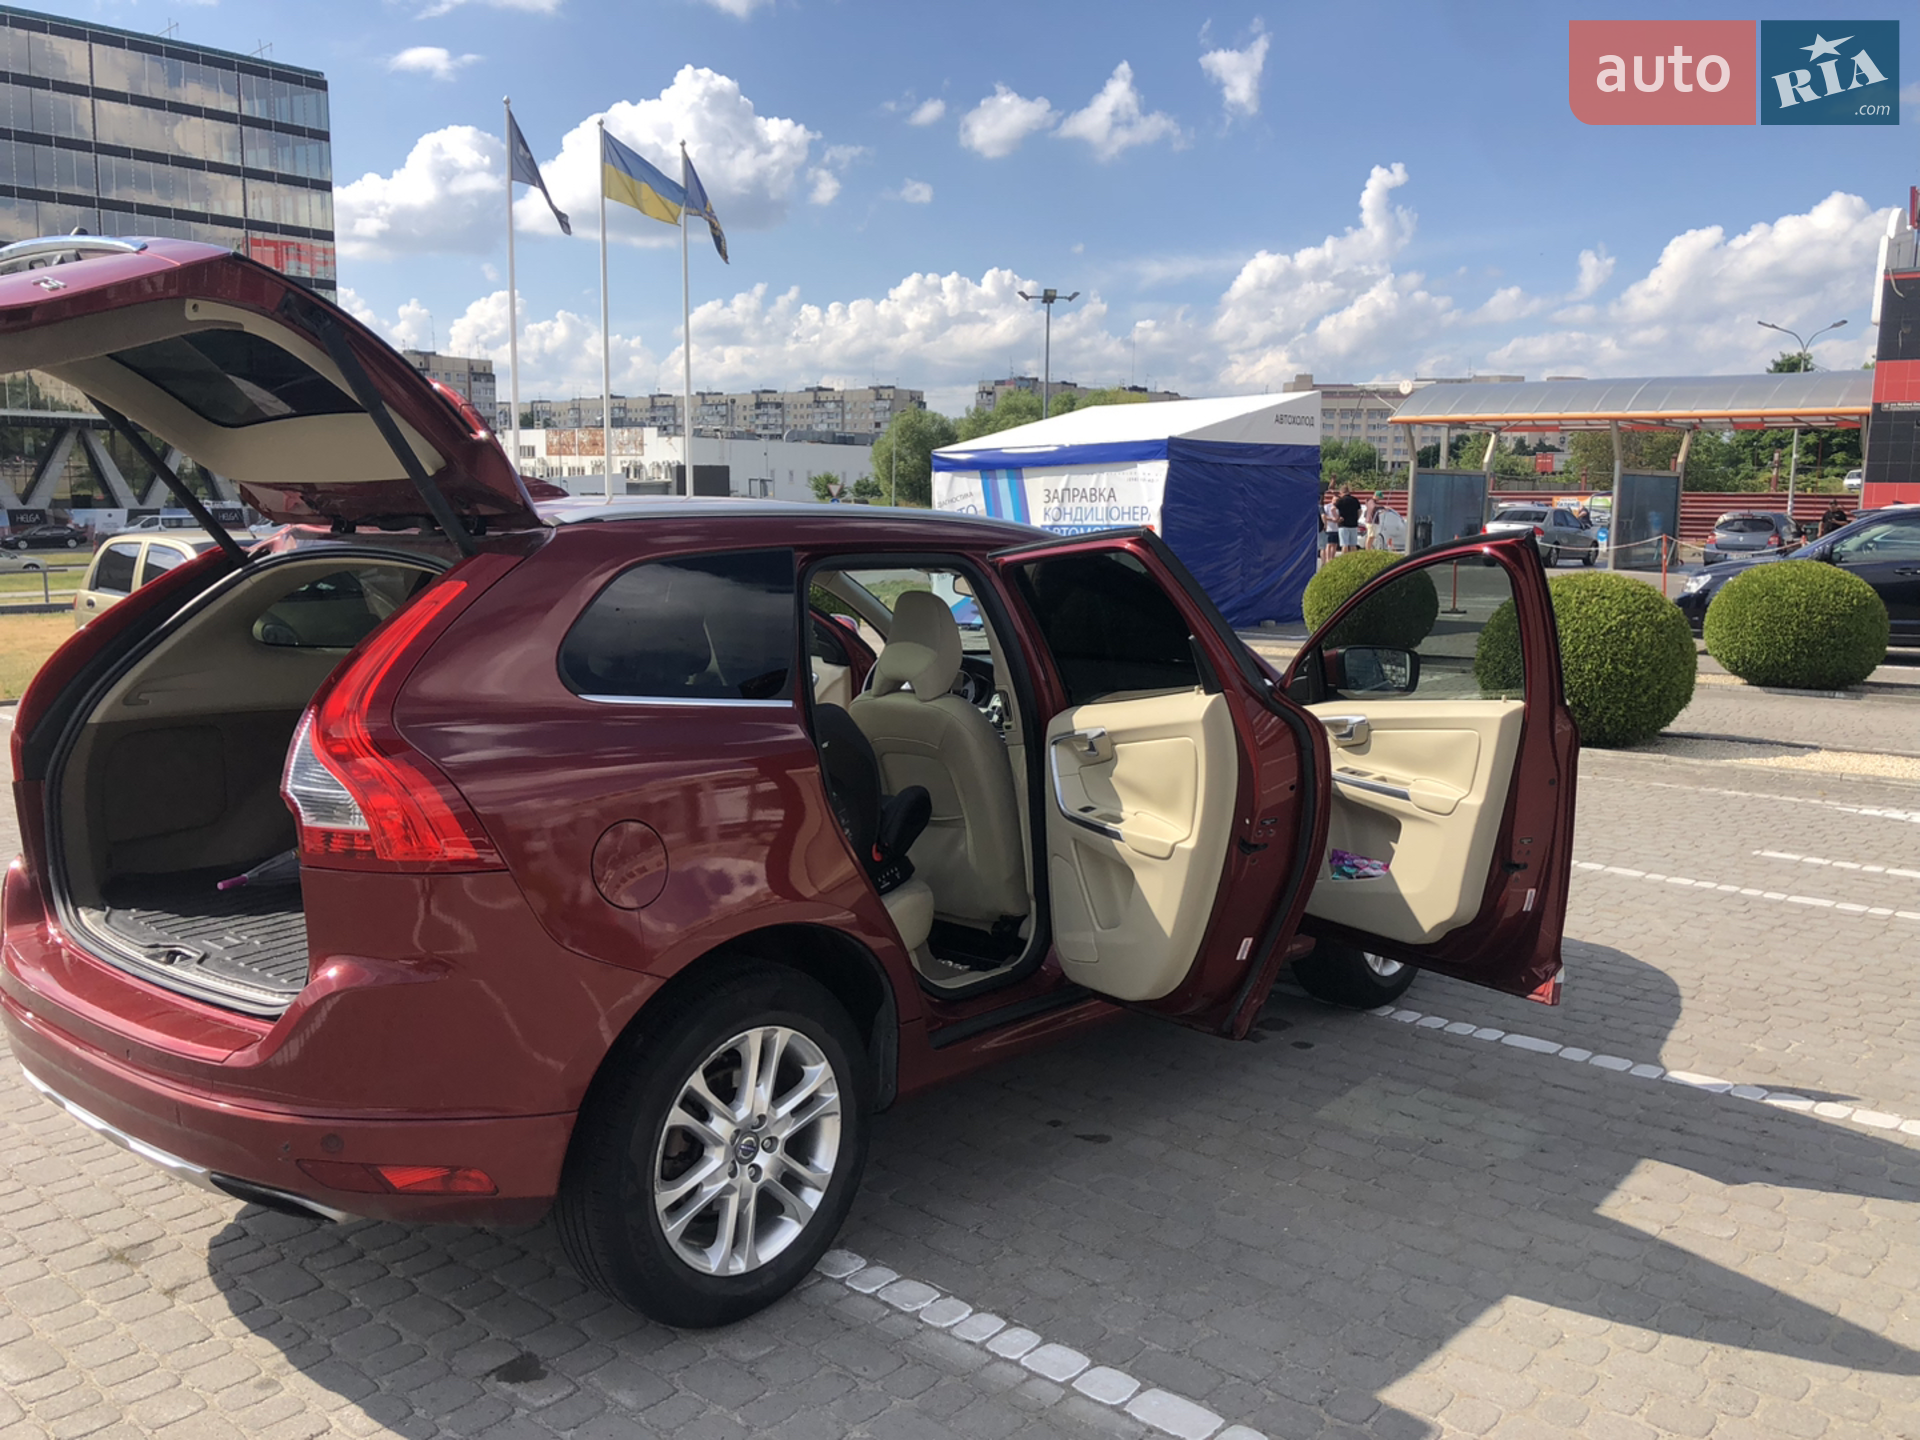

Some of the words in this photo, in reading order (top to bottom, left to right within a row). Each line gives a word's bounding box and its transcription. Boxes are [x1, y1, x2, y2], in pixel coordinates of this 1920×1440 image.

[1043, 487, 1117, 504] ЗАПРАВКА
[15, 512, 41, 524] HELGA
[218, 511, 239, 522] HELGA
